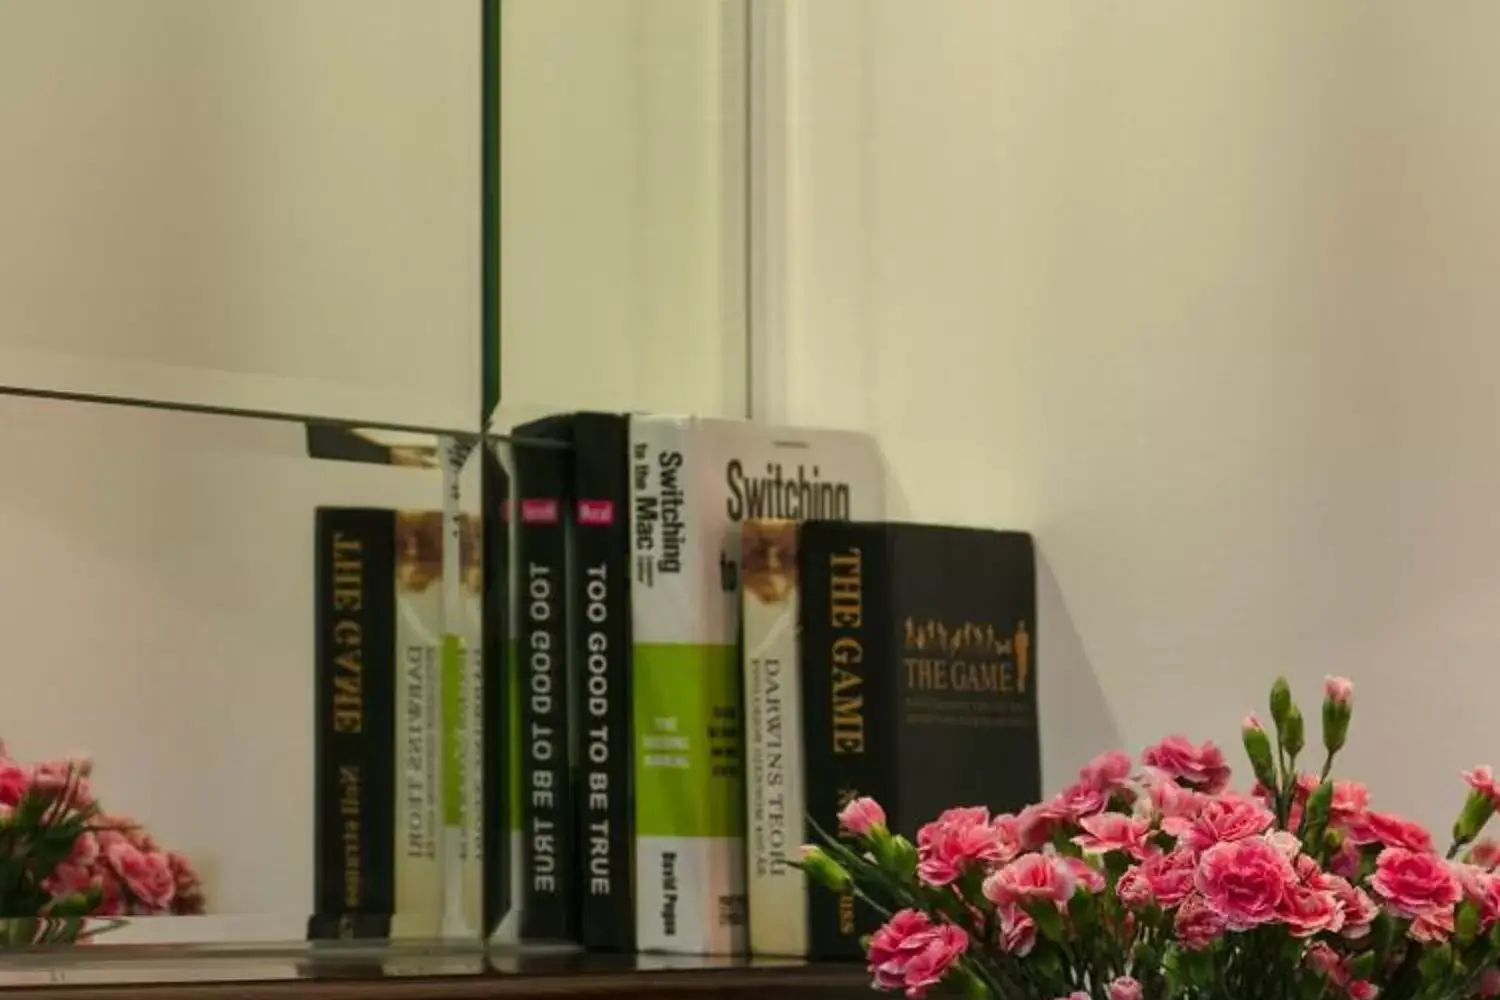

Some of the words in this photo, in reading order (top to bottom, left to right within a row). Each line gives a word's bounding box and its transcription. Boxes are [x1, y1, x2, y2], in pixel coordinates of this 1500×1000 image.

[634, 443, 648, 460] to
[634, 464, 649, 490] the
[658, 450, 686, 574] Switching
[726, 459, 850, 522] Switching
[636, 497, 658, 551] Mac
[586, 563, 607, 623] TOO
[830, 547, 863, 627] THE
[587, 632, 609, 716] GOOD
[832, 637, 865, 753] GAME
[903, 657, 948, 690] THE
[949, 660, 1014, 693] GAME
[588, 725, 609, 763] TO
[764, 658, 783, 787] DARWINS
[589, 772, 609, 812] BE
[589, 819, 610, 896] TRUE
